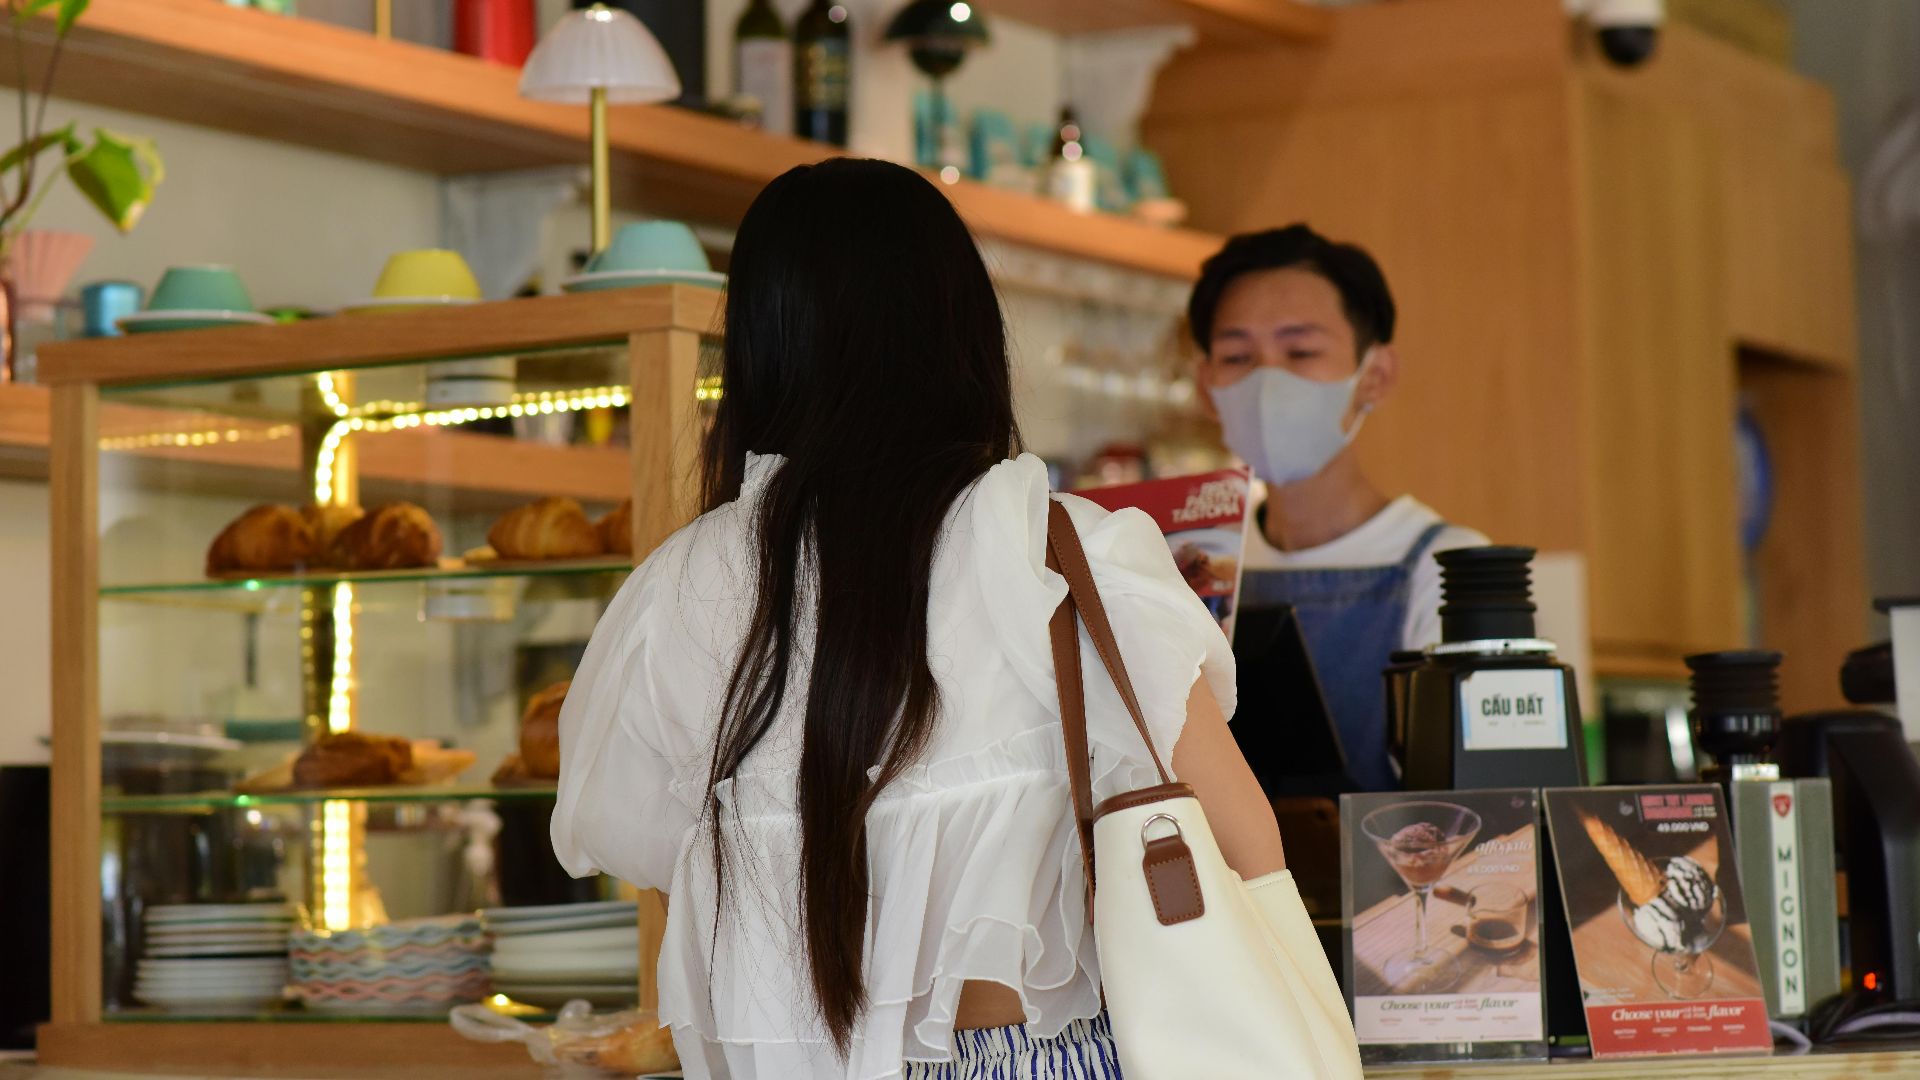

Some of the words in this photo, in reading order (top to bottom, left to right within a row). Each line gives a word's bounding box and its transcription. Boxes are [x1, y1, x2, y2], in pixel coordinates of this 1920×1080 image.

[1777, 846, 1798, 993] MIGNON
[1380, 999, 1420, 1011] Choose
[1424, 1000, 1456, 1012] your
[1478, 997, 1518, 1011] flavor
[1611, 1008, 1653, 1021] Choose
[1655, 1009, 1684, 1022] your
[1707, 1005, 1745, 1020] flavor
